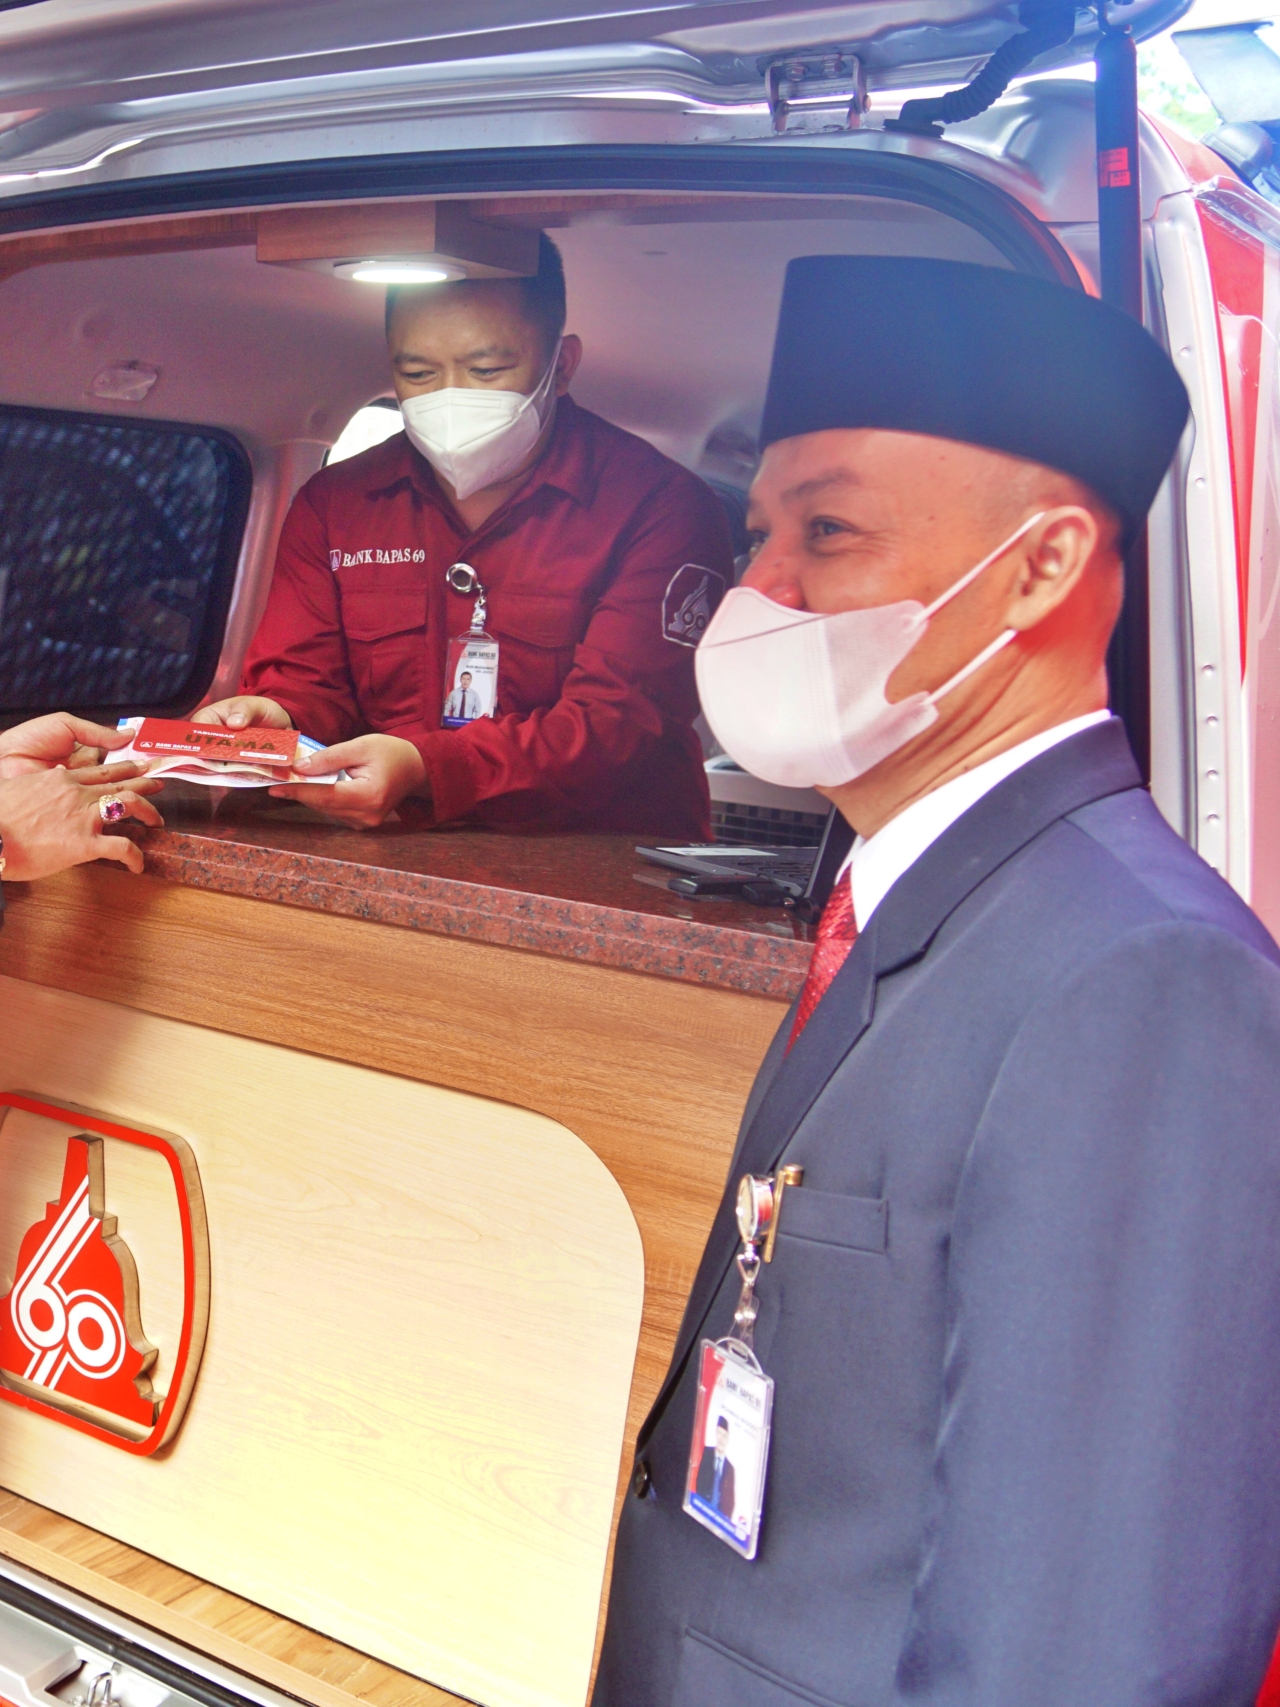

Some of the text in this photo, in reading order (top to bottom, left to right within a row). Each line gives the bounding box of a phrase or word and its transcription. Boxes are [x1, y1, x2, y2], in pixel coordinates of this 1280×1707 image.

[342, 547, 426, 568] BANK BAPAS 69
[185, 733, 276, 751] UTAMA
